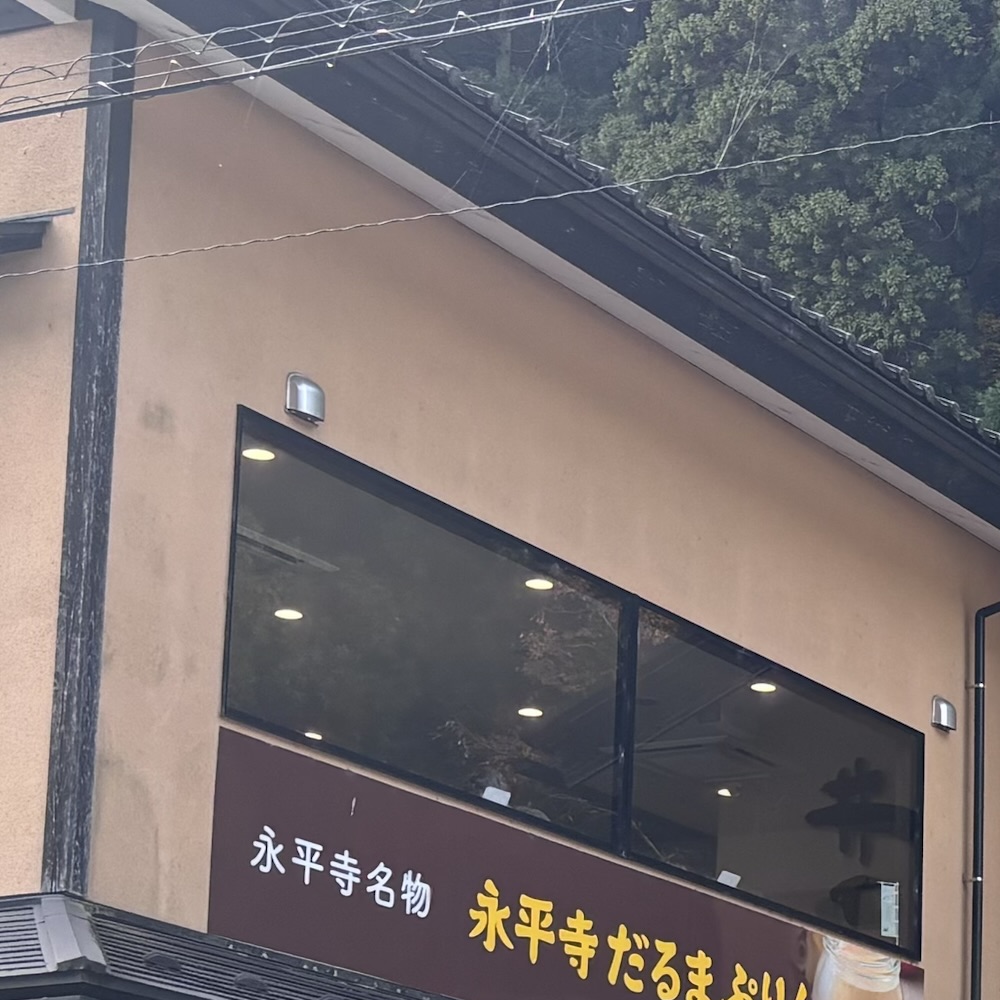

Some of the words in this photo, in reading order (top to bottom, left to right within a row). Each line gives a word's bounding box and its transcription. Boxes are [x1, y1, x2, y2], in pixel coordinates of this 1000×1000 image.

[250, 825, 432, 918] 永平寺名物
